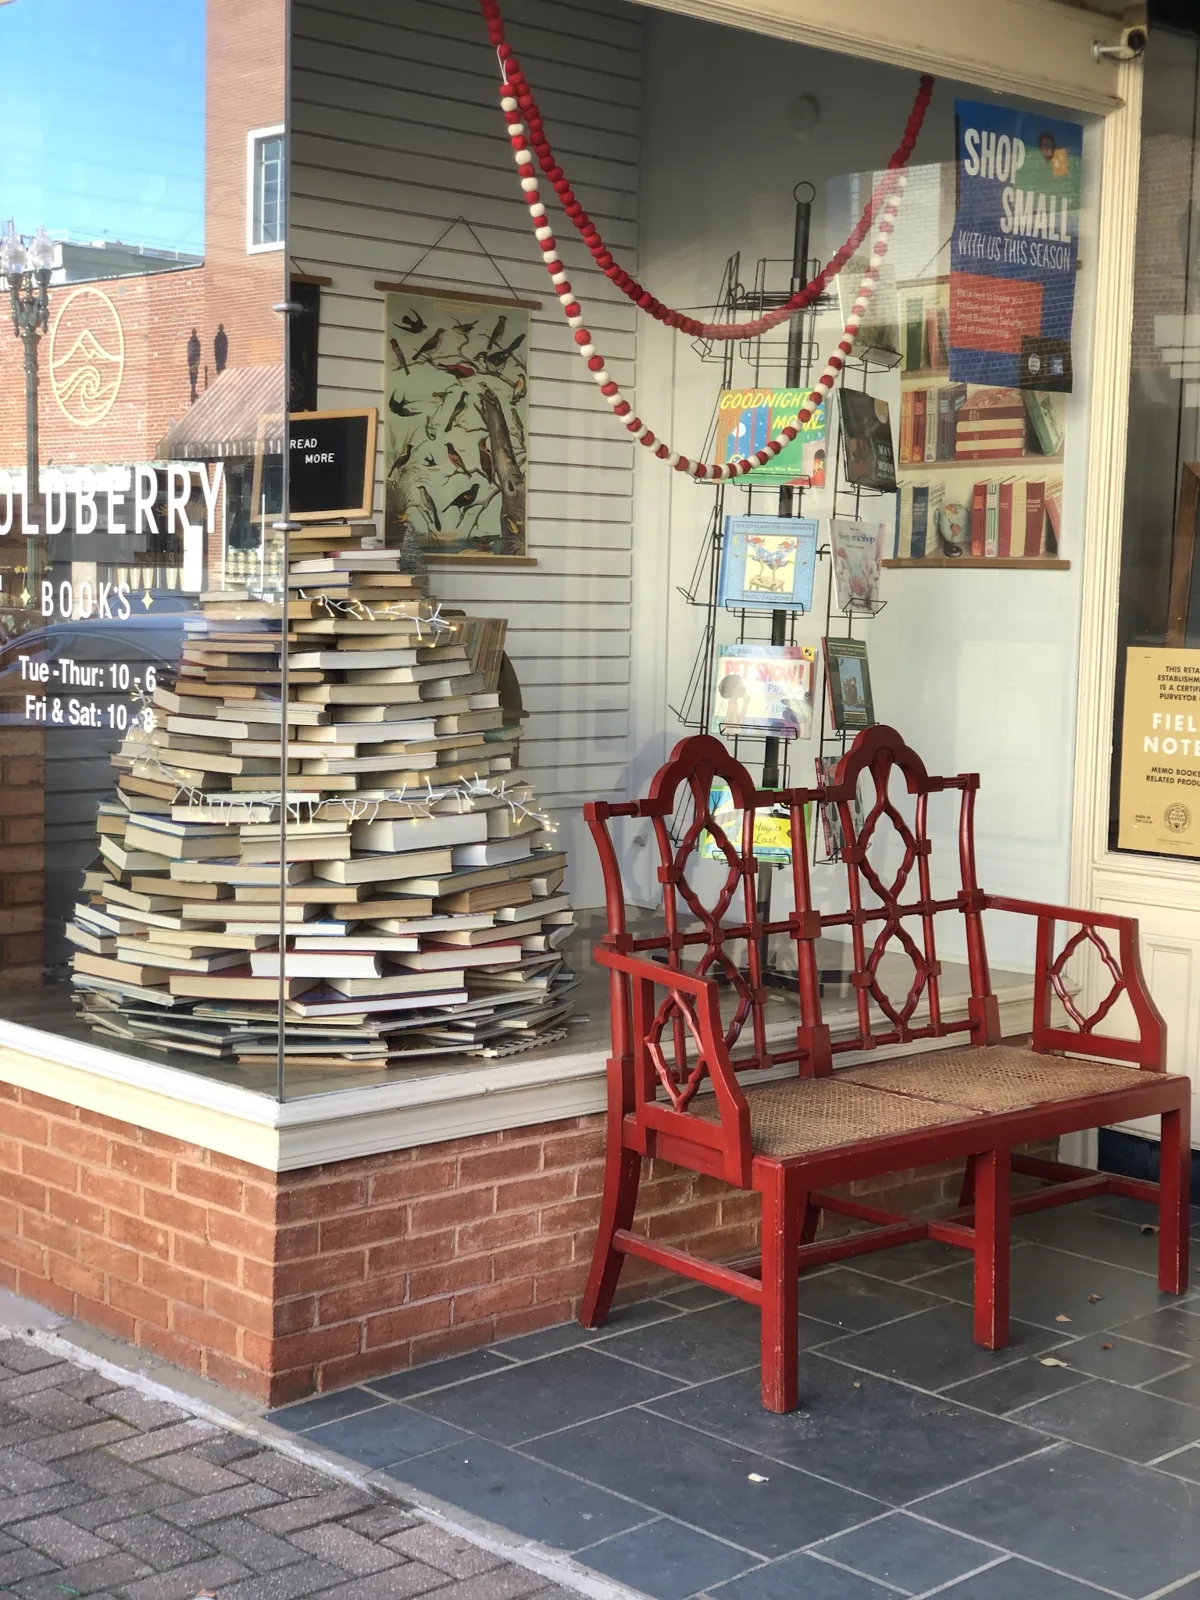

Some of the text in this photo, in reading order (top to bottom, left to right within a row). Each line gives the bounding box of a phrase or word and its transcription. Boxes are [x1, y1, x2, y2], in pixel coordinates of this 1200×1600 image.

[964, 128, 1025, 184] SHOP
[1001, 186, 1071, 243] SMALL
[958, 229, 1071, 271] WITH US THIS SEASON
[720, 391, 812, 410] GOODNIGHT
[289, 438, 318, 449] READ
[305, 453, 335, 464] MORE
[41, 580, 131, 620] BOOKS
[1165, 665, 1181, 673] THIS
[109, 663, 130, 690] 10
[145, 666, 156, 693] 6
[1160, 683, 1167, 691] IS
[1159, 692, 1197, 702] PURVEYOR
[25, 694, 47, 721] Fri
[51, 697, 64, 724] &
[68, 698, 102, 728] Sat:
[107, 703, 128, 731] 10
[1151, 766, 1174, 775] MEMO
[1146, 774, 1175, 784] RELATED
[753, 833, 777, 844] Lost
